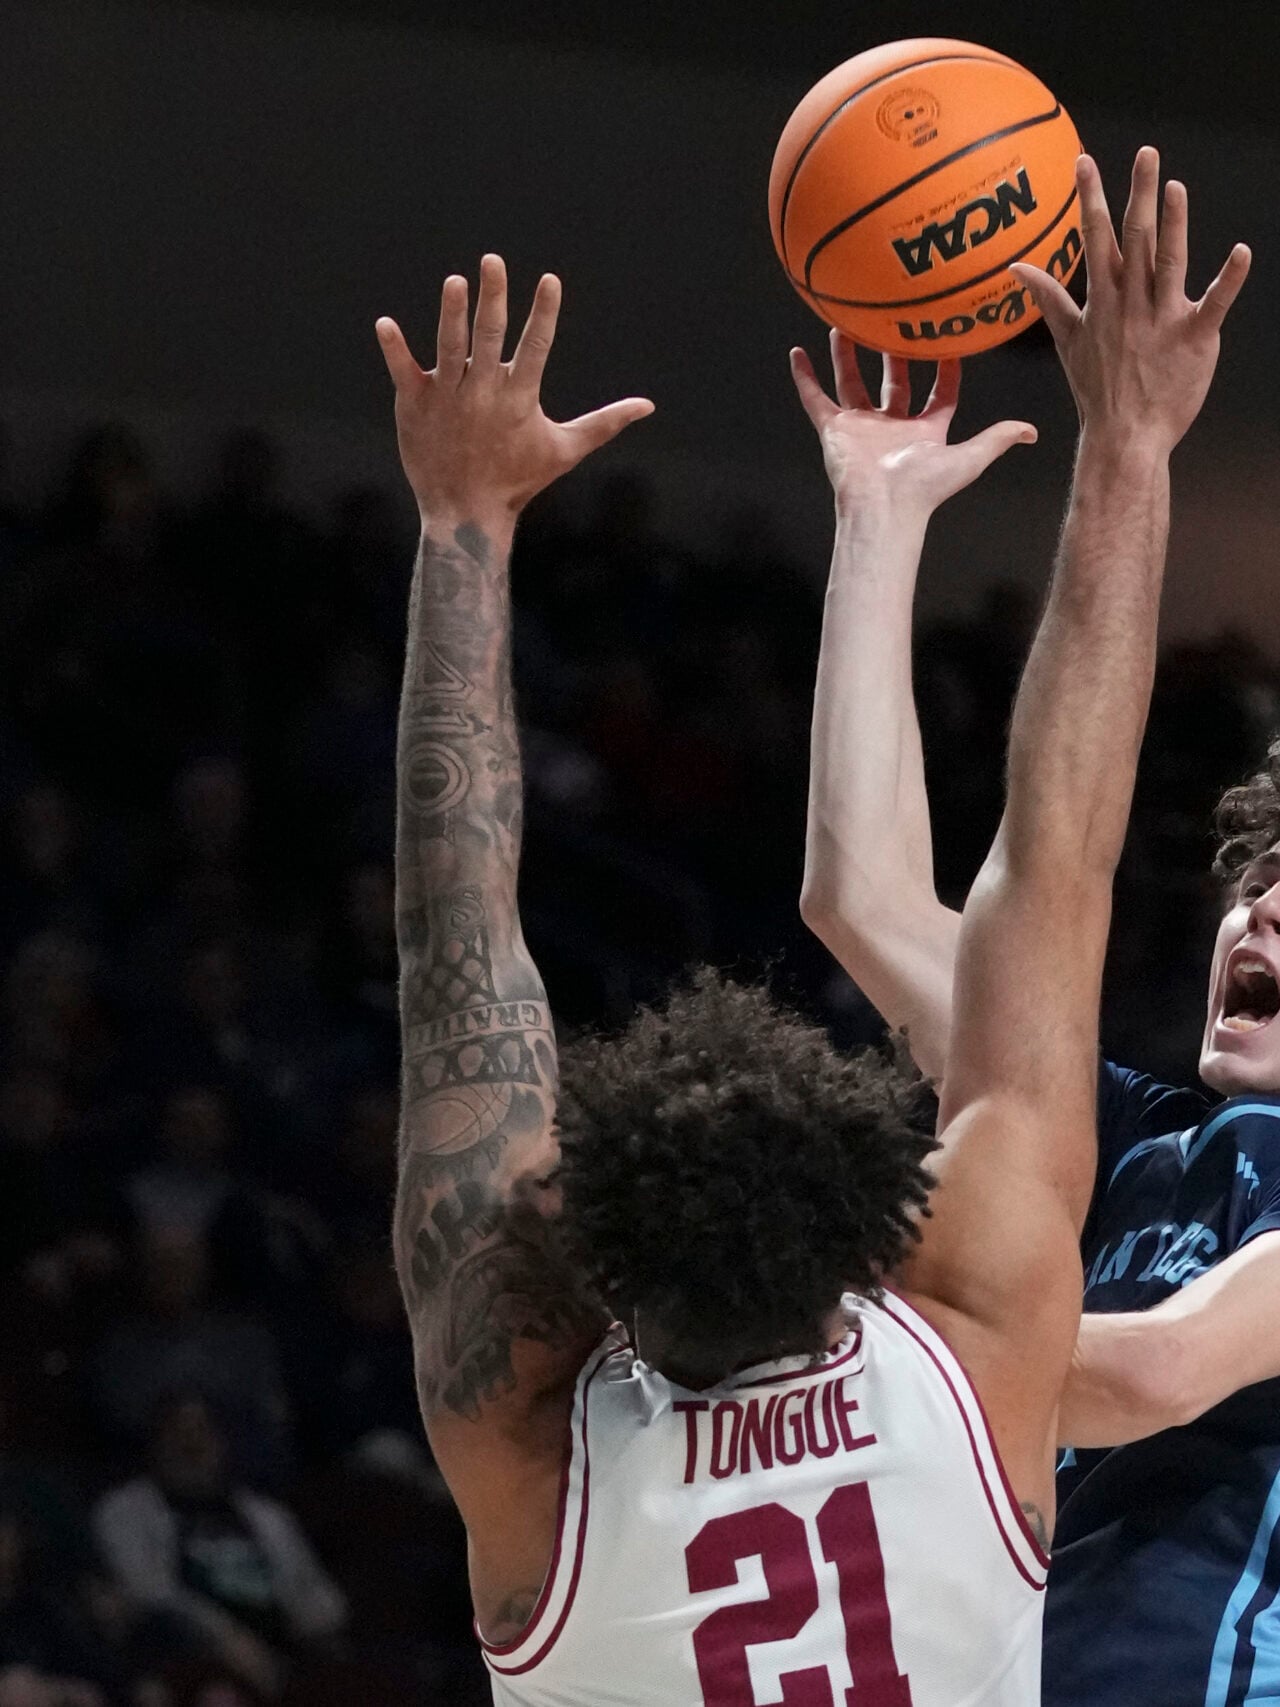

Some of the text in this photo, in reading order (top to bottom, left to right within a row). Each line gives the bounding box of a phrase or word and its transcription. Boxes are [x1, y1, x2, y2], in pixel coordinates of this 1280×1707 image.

[891, 165, 1038, 277] NCAA
[895, 226, 1084, 341] Wlson
[672, 1377, 877, 1484] TONGUE
[684, 1480, 914, 1707] 21
